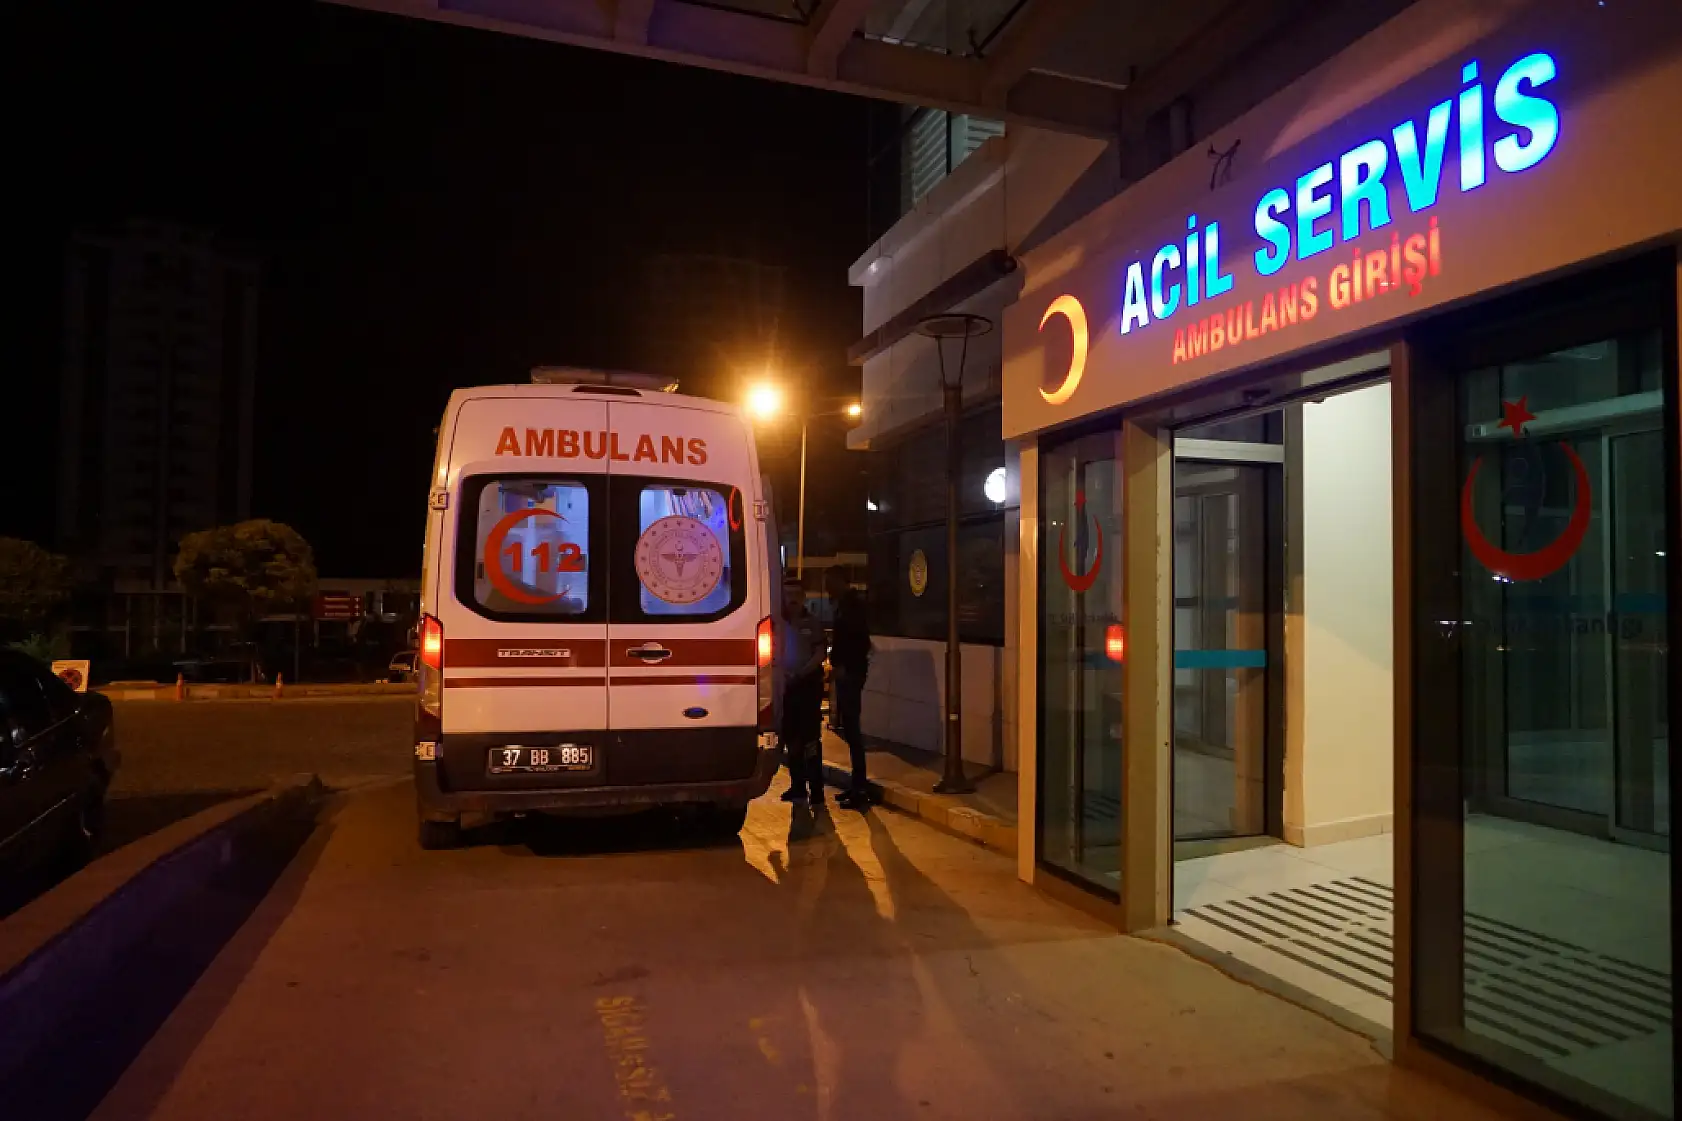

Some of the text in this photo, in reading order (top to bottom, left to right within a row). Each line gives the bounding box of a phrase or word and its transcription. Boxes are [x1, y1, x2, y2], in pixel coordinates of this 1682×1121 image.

[1120, 51, 1559, 335] ACİL SERVİS
[1173, 216, 1441, 365] AMBULANS GİRİŞİ
[494, 426, 709, 466] AMBULANS
[503, 542, 582, 573] 112
[502, 749, 521, 766] 37
[561, 747, 588, 764] 885
